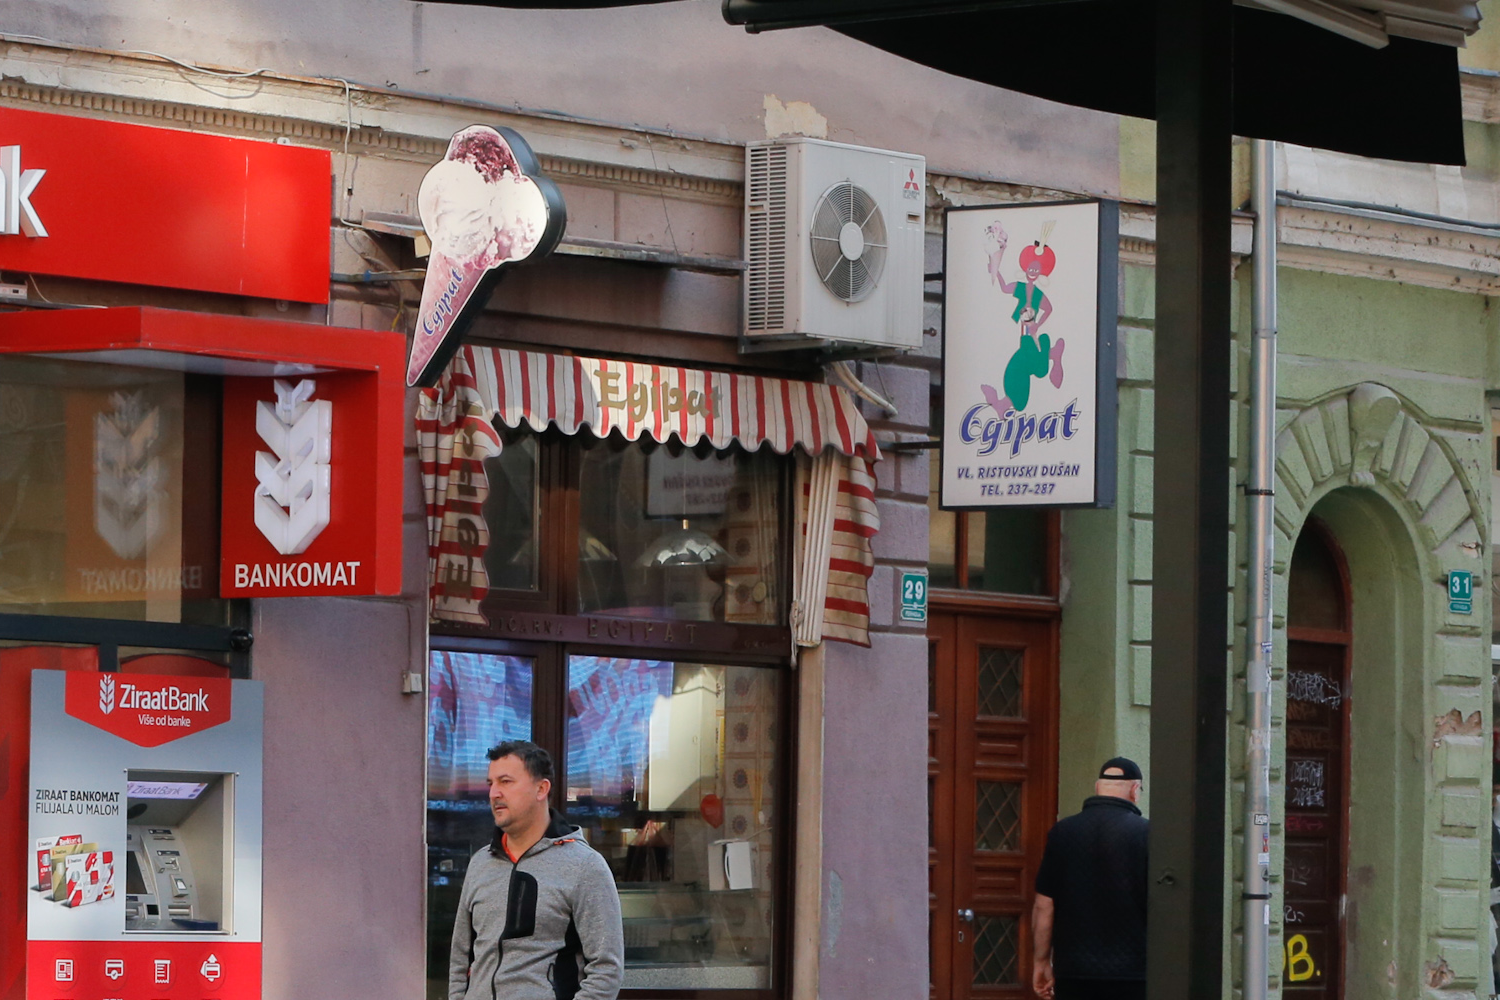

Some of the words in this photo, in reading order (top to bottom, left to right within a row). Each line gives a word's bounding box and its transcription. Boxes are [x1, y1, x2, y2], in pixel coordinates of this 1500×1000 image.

[422, 265, 464, 335] Egipat
[593, 369, 723, 423] Egipat
[959, 398, 1082, 459] Egipat
[957, 467, 974, 479] VL.
[978, 465, 1038, 479] RISTOVSKI
[1041, 462, 1080, 477] DUŠAN
[981, 485, 1004, 496] TEL.
[1007, 483, 1055, 495] 237-287
[235, 561, 361, 588] BANKOMAT
[904, 580, 924, 599] 29
[1452, 576, 1470, 593] 31
[587, 617, 697, 644] EGIPAT
[119, 683, 209, 713] ZiraatBank
[138, 714, 155, 726] Više
[155, 715, 166, 726] od
[167, 716, 191, 727] banke
[36, 789, 67, 801] ZIRAAT
[70, 791, 120, 803] BANKOMAT
[35, 803, 74, 815] FILIJALA
[76, 804, 84, 815] U
[86, 804, 119, 816] MALOM
